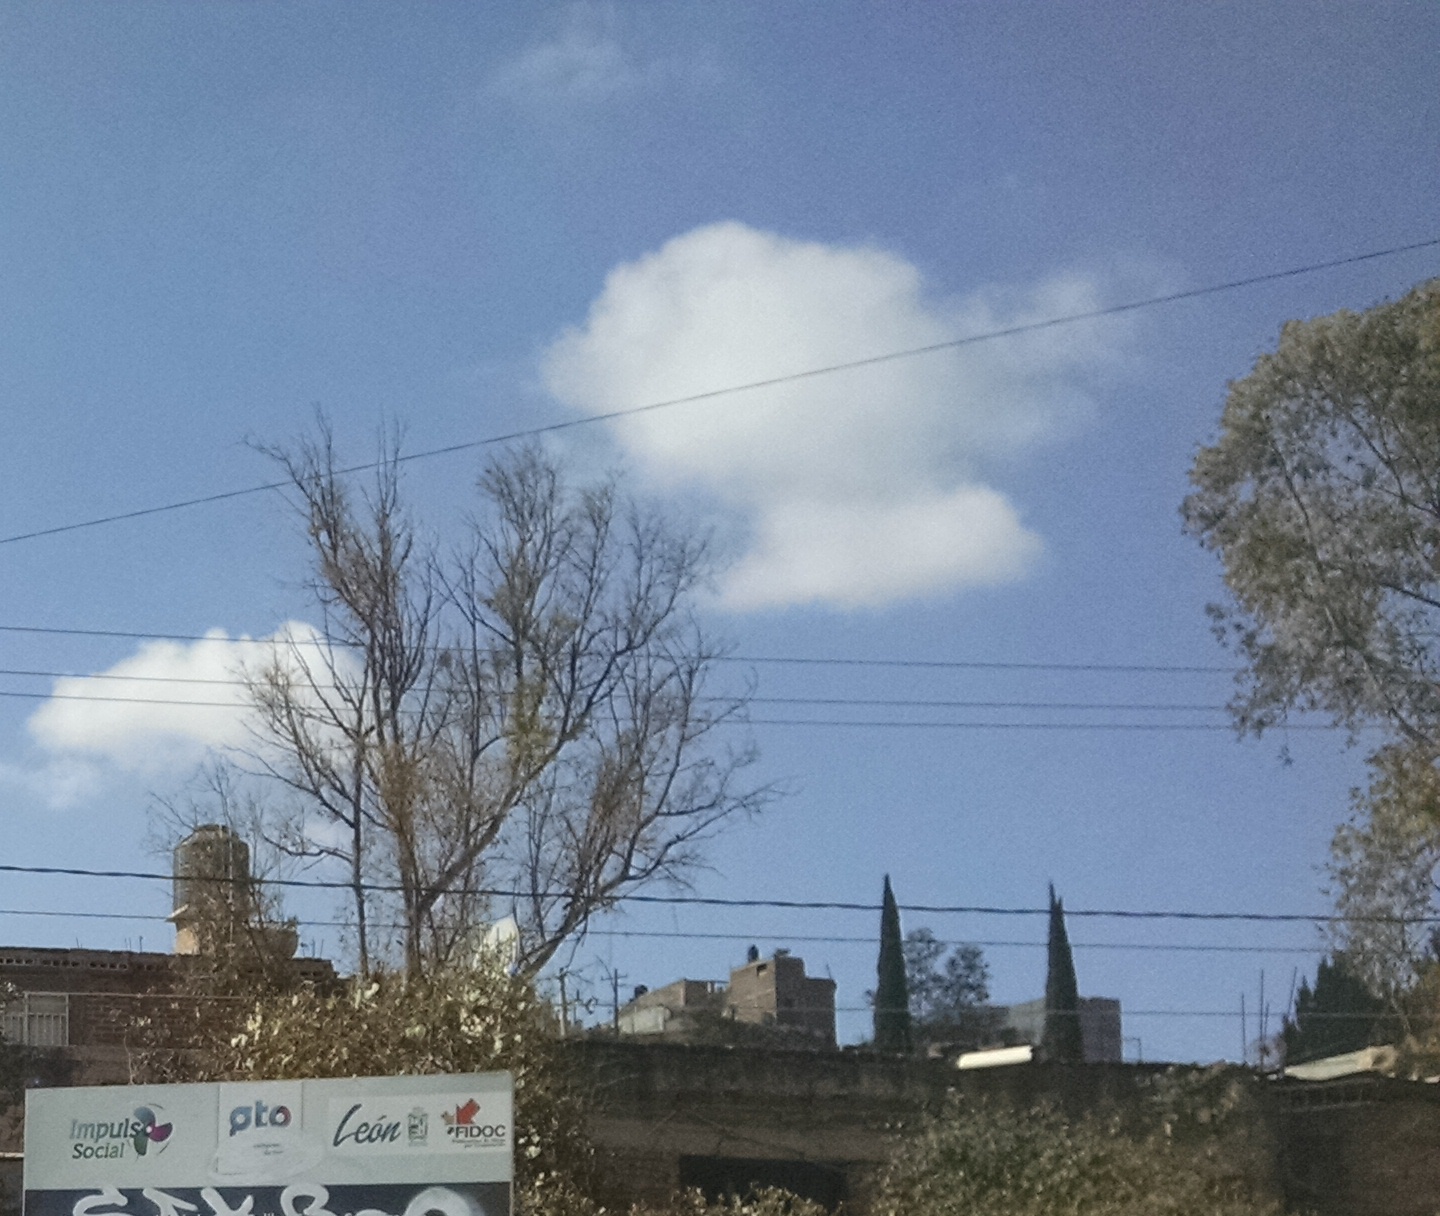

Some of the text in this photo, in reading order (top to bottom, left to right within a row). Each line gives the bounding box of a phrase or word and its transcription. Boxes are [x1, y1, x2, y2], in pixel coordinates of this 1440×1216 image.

[332, 1103, 401, 1147] León
[455, 1125, 506, 1138] FIDOC
[72, 1142, 125, 1159] Social
